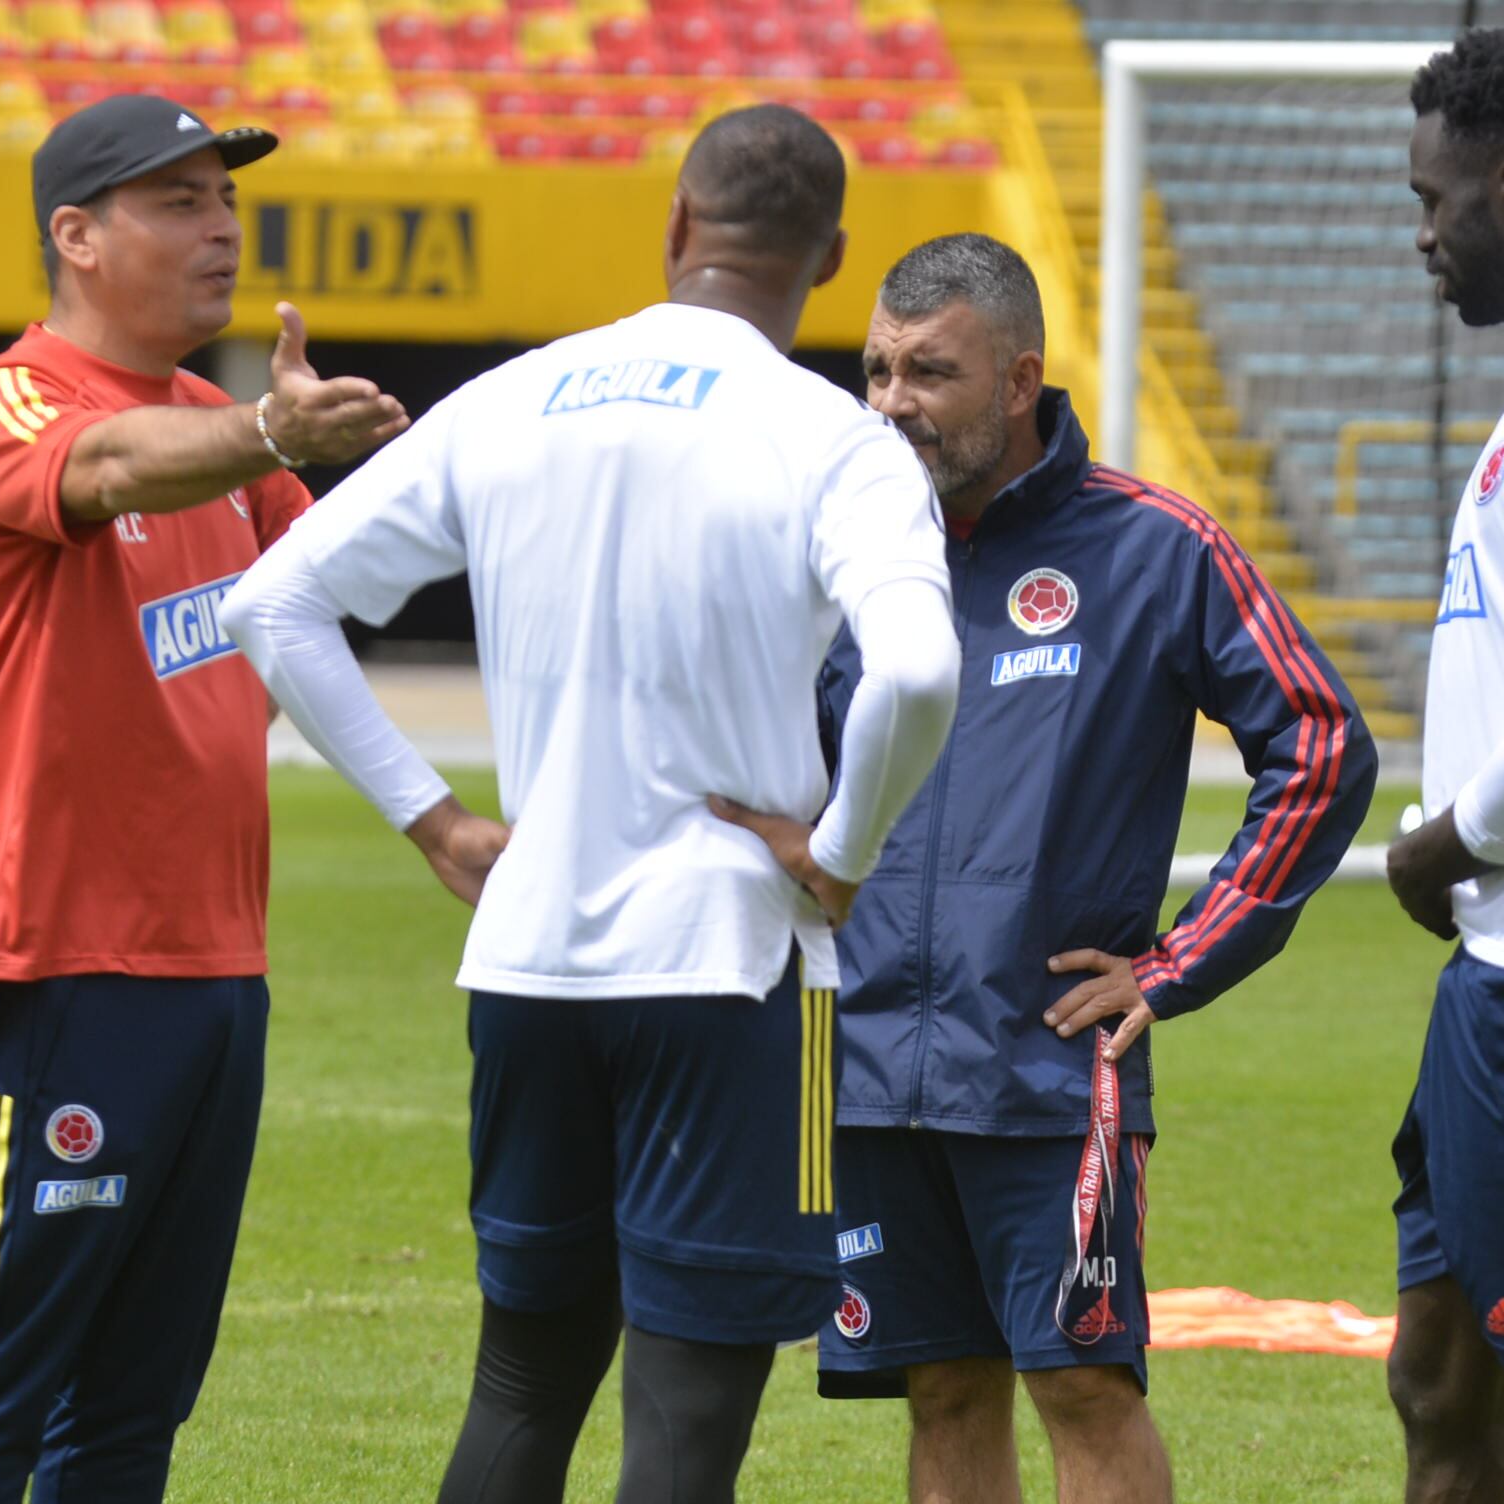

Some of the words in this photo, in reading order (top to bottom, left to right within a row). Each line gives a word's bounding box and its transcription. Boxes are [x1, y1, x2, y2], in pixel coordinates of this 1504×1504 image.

[238, 203, 476, 294] LIDA
[548, 360, 704, 411] AGUILA
[154, 584, 233, 670] AGUI
[998, 647, 1072, 681] AGUILA
[41, 1180, 118, 1209] AGUILA
[837, 1228, 877, 1259] UILA
[1073, 1321, 1127, 1335] adidas
